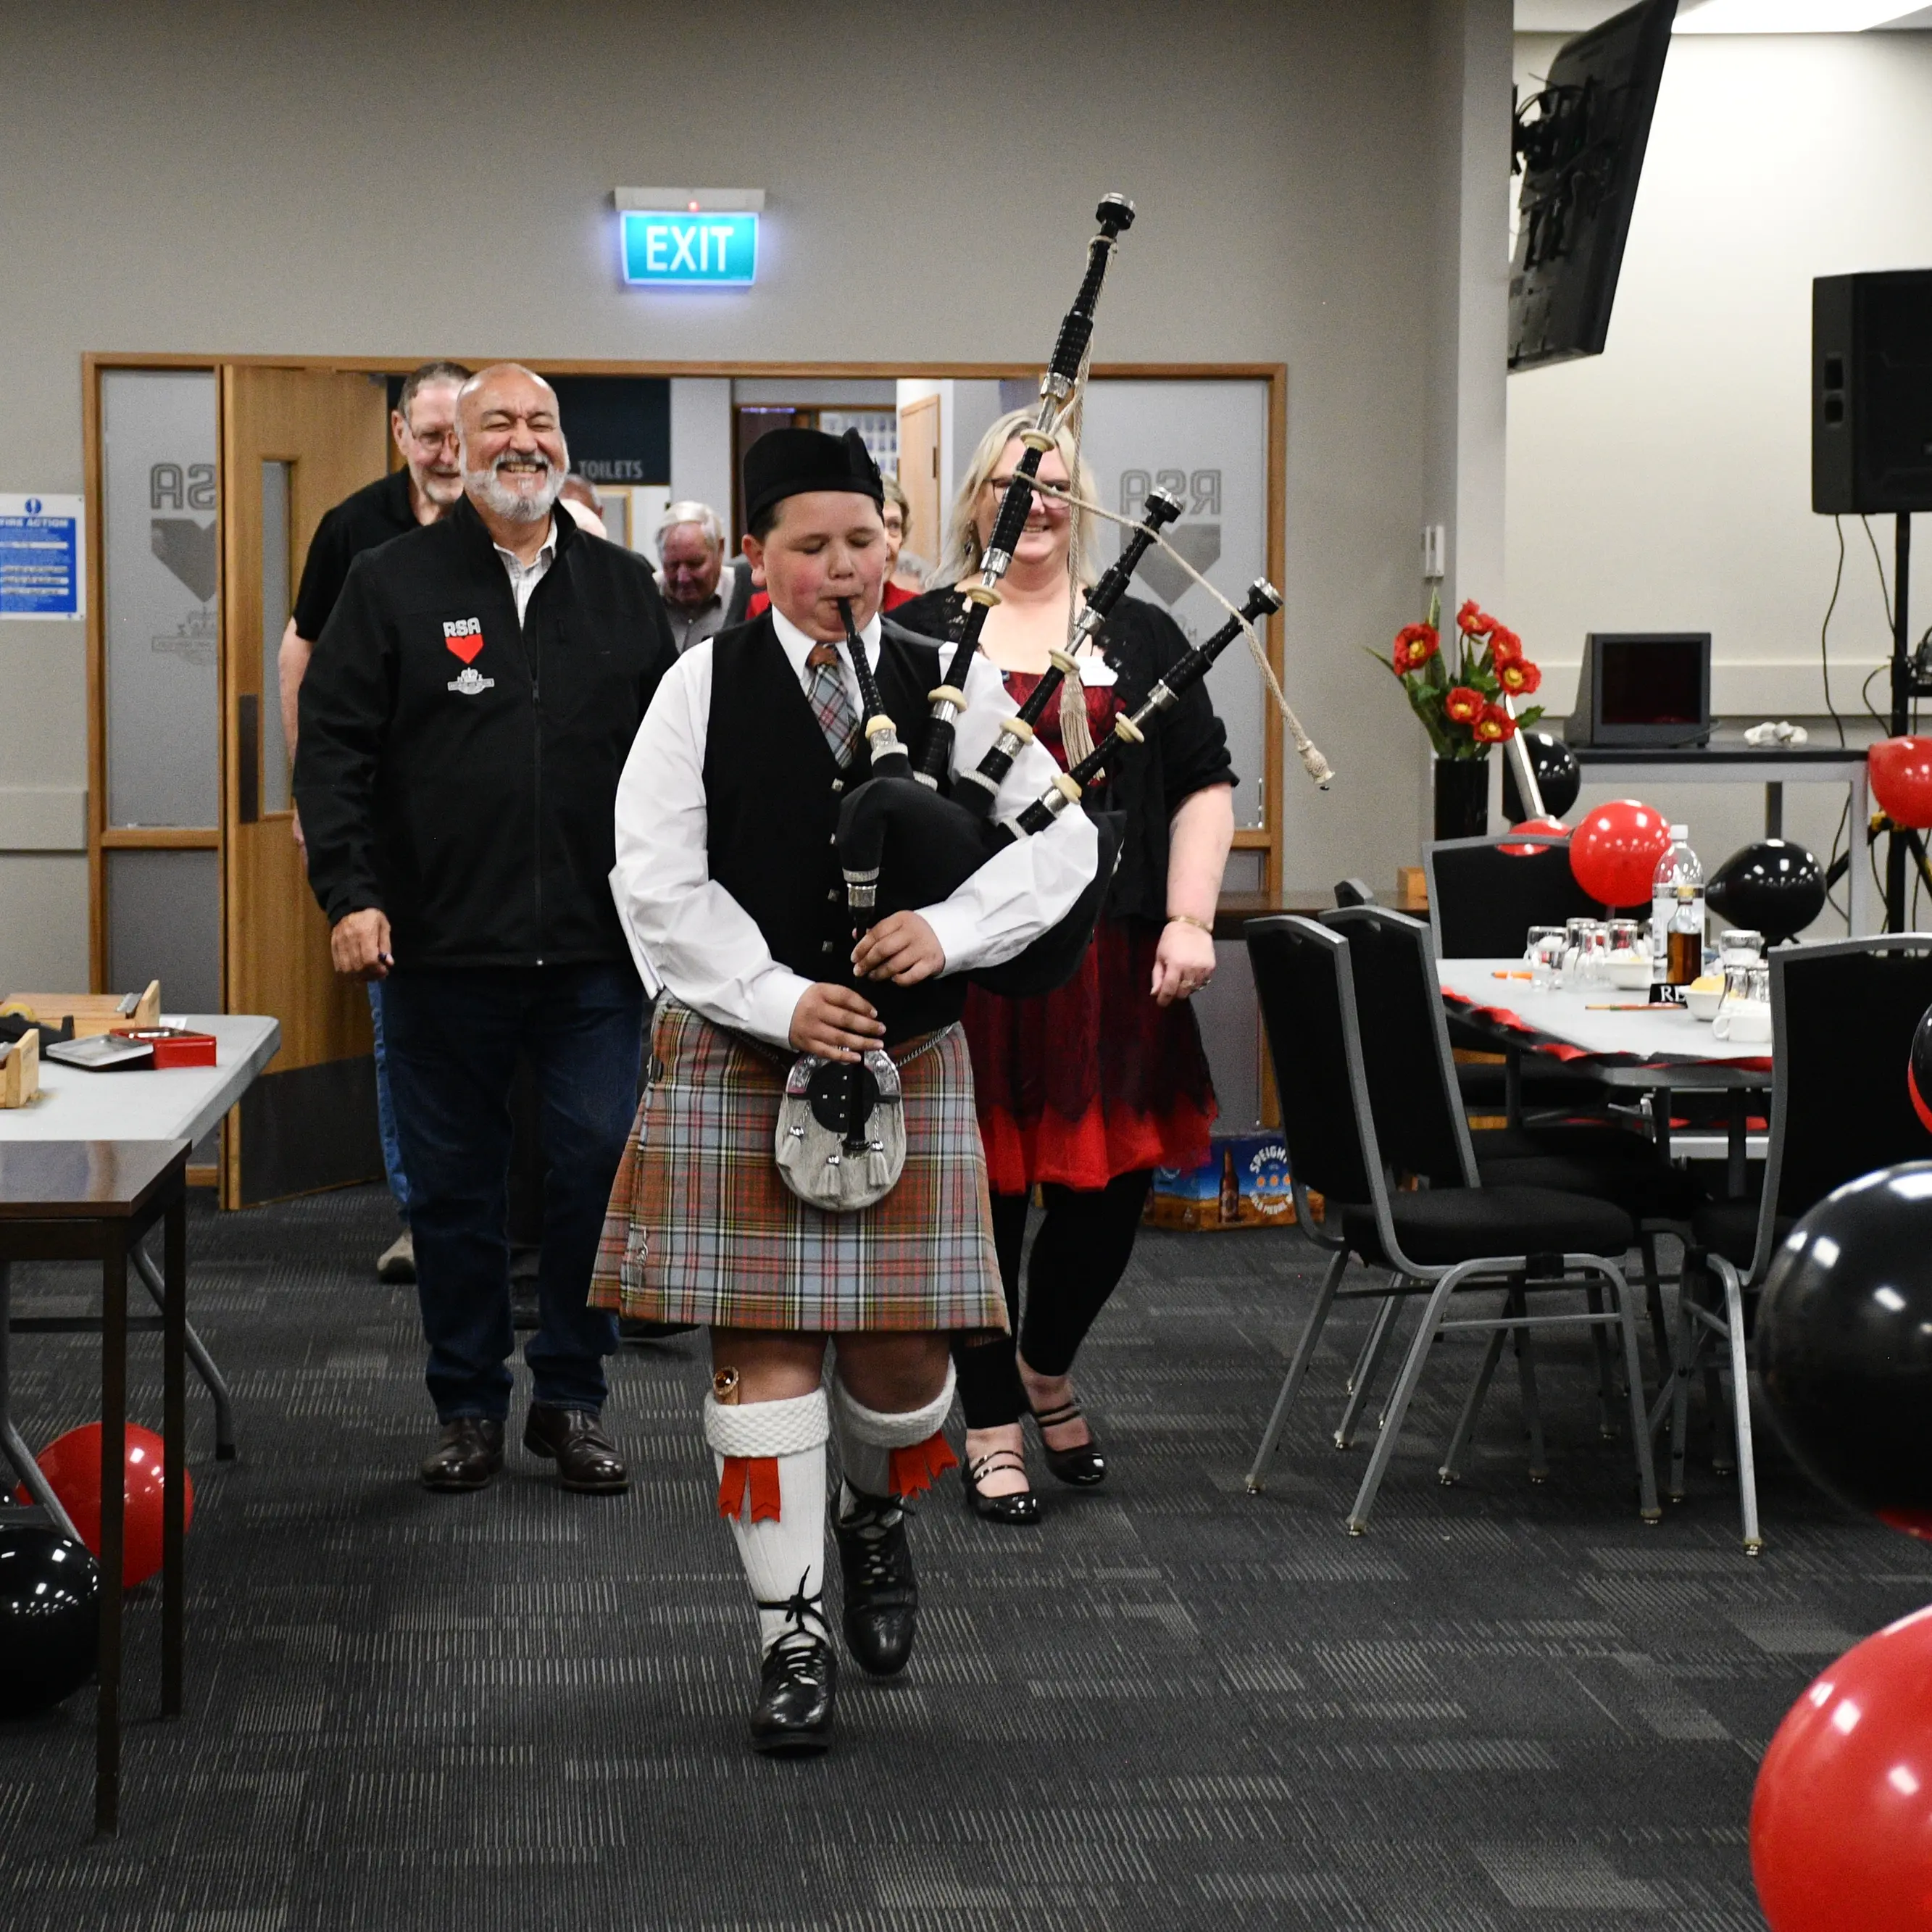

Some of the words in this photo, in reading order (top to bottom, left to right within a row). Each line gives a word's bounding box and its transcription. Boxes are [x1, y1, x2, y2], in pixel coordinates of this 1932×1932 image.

[646, 225, 734, 272] EXIT
[578, 459, 644, 479] TOILETS
[443, 617, 481, 638] RSA
[1249, 1144, 1288, 1174] SPEIGH
